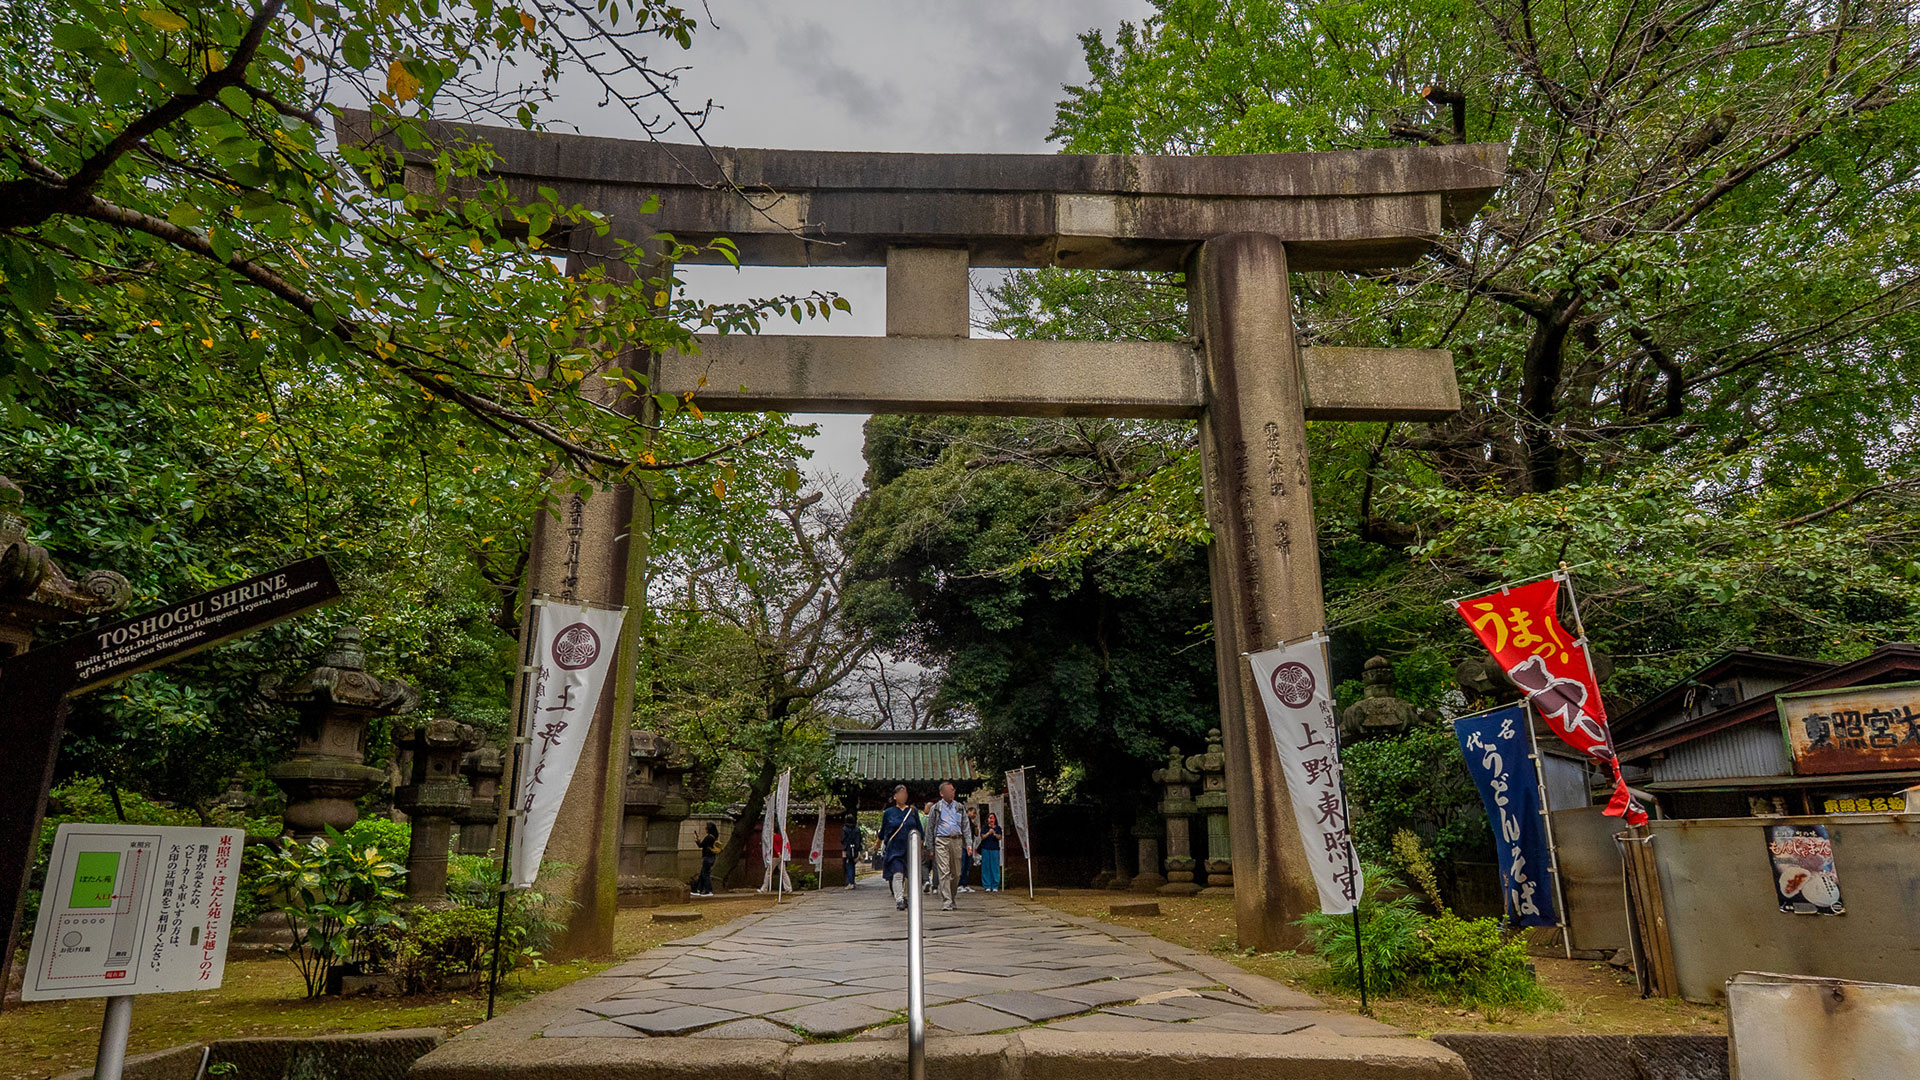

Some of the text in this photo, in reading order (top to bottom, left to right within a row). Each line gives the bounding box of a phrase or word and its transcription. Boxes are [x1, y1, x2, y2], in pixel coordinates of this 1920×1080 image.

[75, 654, 101, 670] Built
[102, 651, 113, 660] in
[193, 608, 239, 628] Tokugawa
[285, 581, 319, 599] founder
[98, 573, 288, 650] TOSHOGU SHRINE
[106, 647, 155, 666] Tokugawa
[156, 630, 206, 651] Shogunate.
[1296, 722, 1359, 901] 上野東照宮
[1823, 797, 1905, 814] 東照宮名物
[130, 841, 152, 849] 東照宮
[95, 893, 111, 901] 入口
[199, 835, 233, 981] 東照宮・ぼたん苑にお越しの方
